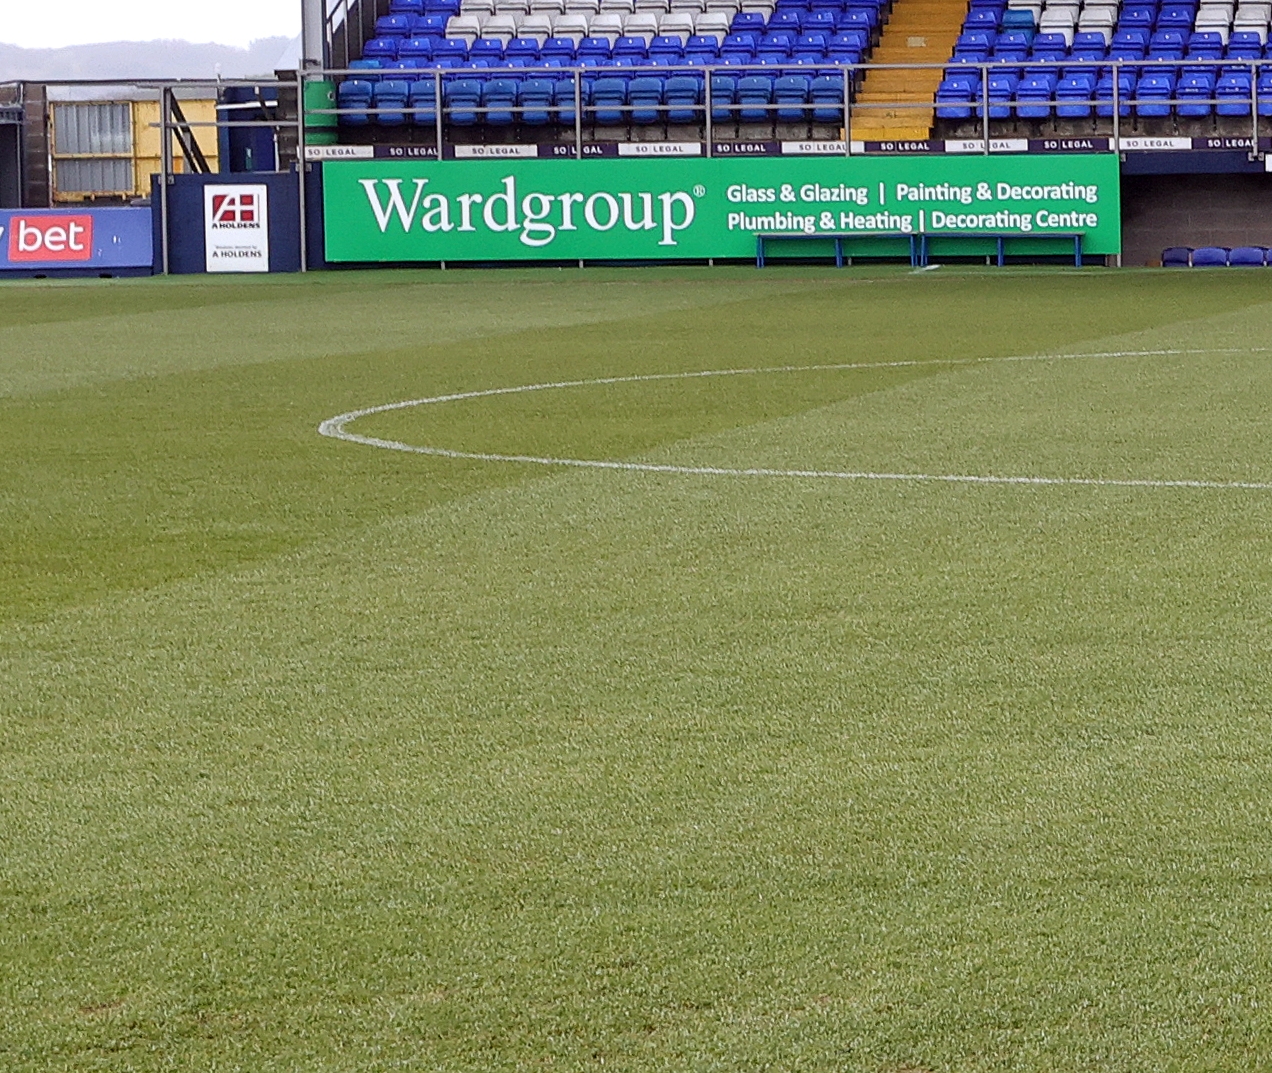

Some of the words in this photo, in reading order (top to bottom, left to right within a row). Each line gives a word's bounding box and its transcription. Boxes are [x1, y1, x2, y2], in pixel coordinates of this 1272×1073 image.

[881, 142, 893, 150] SO
[899, 142, 929, 150] LEGAL
[1044, 140, 1057, 148] SO
[1062, 140, 1093, 148] LEGAL
[1208, 139, 1220, 147] SO
[554, 146, 566, 154] SO
[572, 146, 602, 154] LGAL
[636, 145, 648, 153] SO
[653, 145, 684, 153] LEGAL
[717, 144, 729, 152] SO
[735, 144, 766, 152] LEGAL
[727, 183, 776, 203] Glass
[780, 184, 796, 203] &
[799, 183, 868, 205] Glazing
[896, 183, 972, 205] Painting
[975, 184, 992, 202] &
[997, 181, 1098, 204] Decorating
[727, 211, 816, 234] Plumbing
[819, 212, 836, 230] &
[840, 211, 912, 233] Heating
[931, 210, 1032, 233] Decorating
[1035, 210, 1097, 228] Centre
[18, 220, 84, 252] bet
